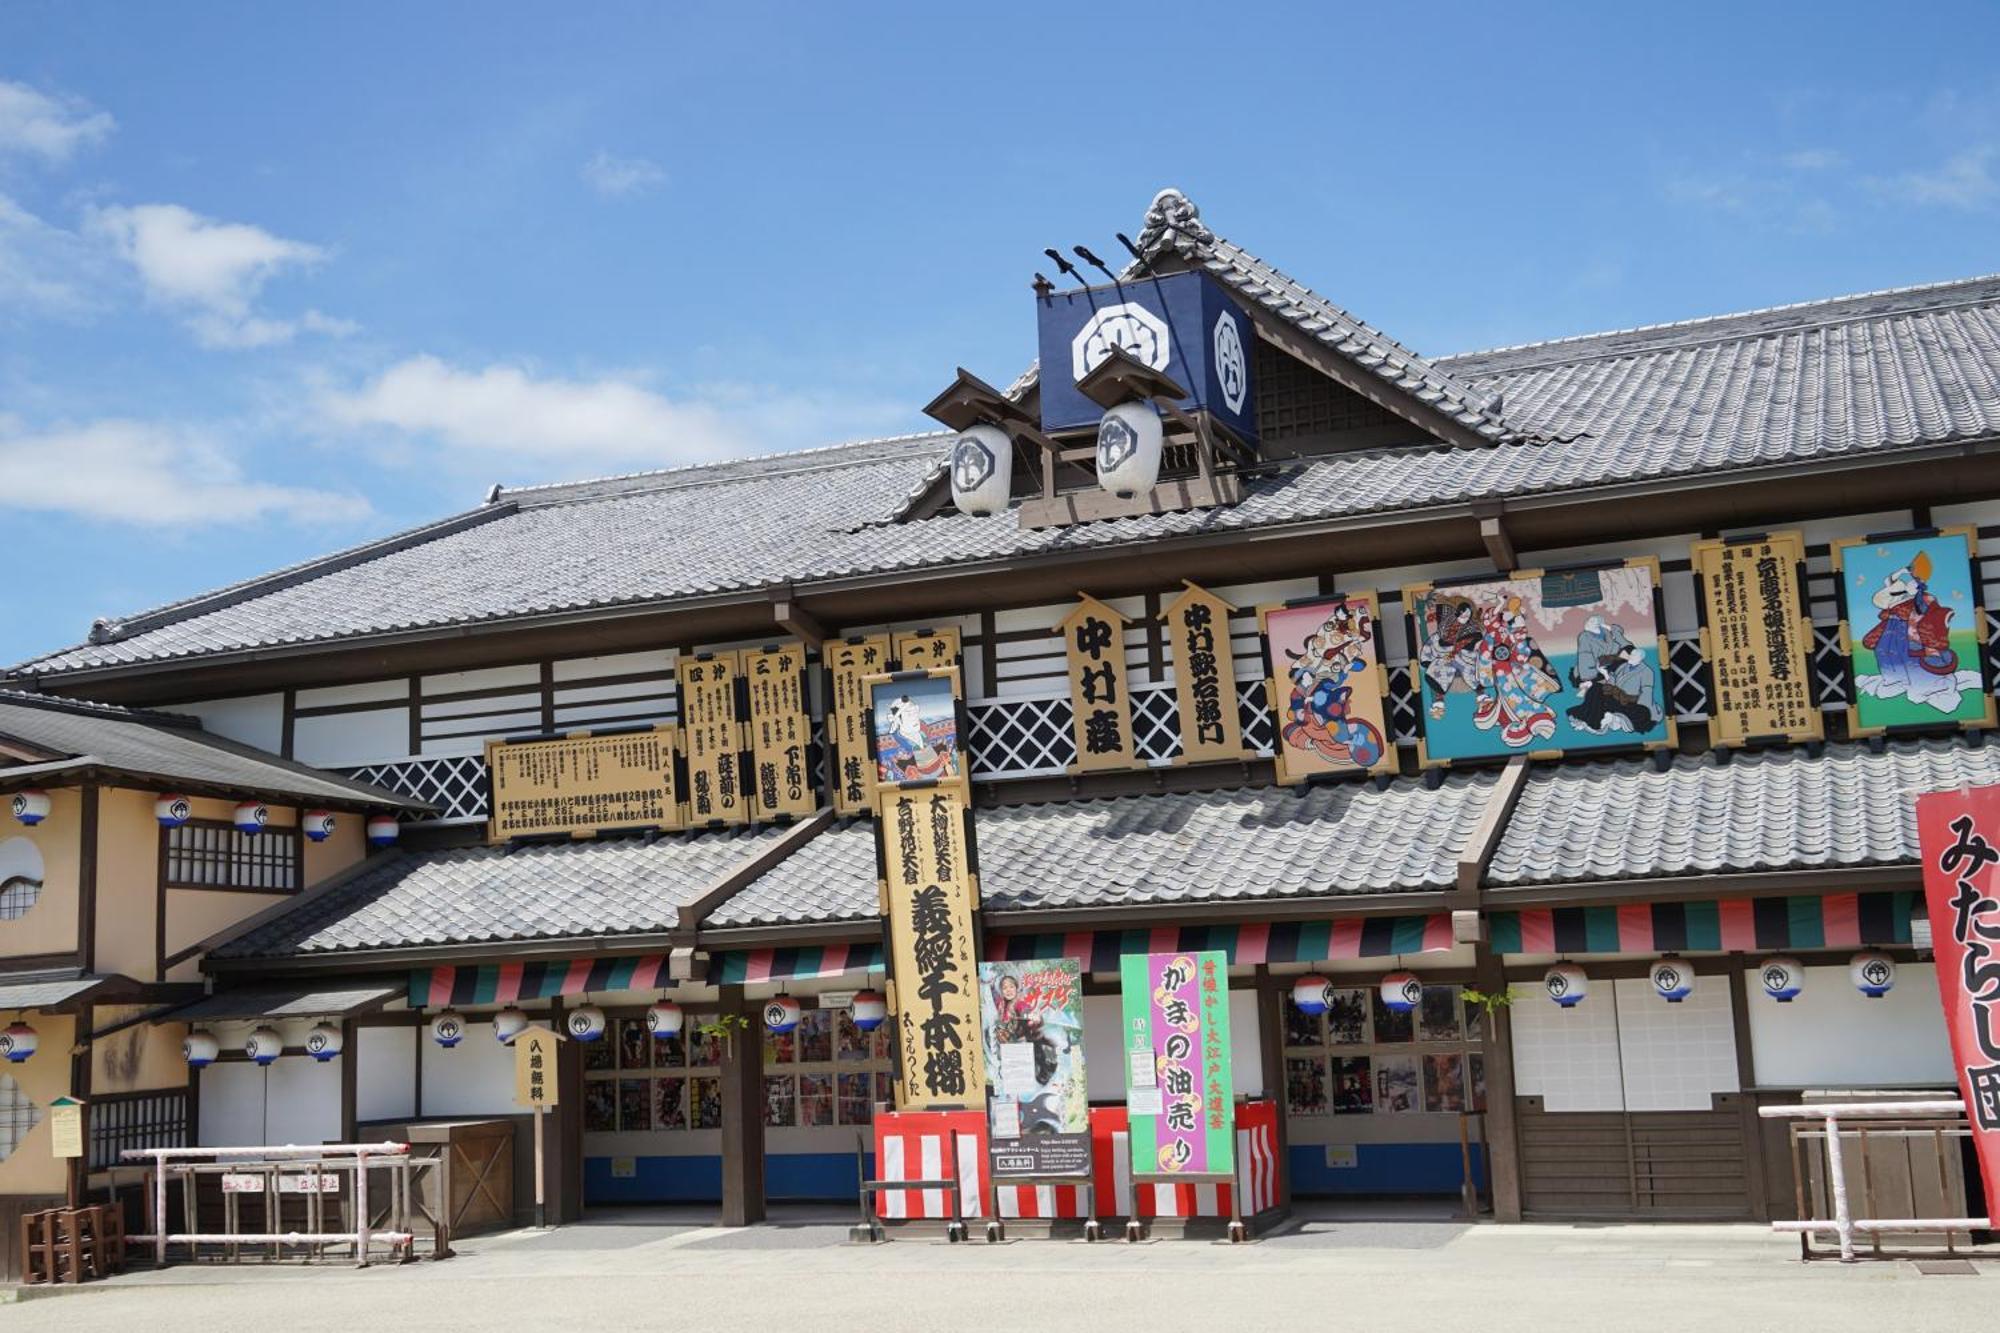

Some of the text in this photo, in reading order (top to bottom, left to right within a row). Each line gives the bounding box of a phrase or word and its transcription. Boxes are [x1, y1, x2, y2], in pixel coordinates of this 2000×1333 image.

[1077, 616, 1123, 755] 中村座
[1184, 603, 1225, 745] 中村歌右衛門
[530, 1039, 544, 1101] 入場無料
[1163, 965, 1196, 1165] がまの油売り
